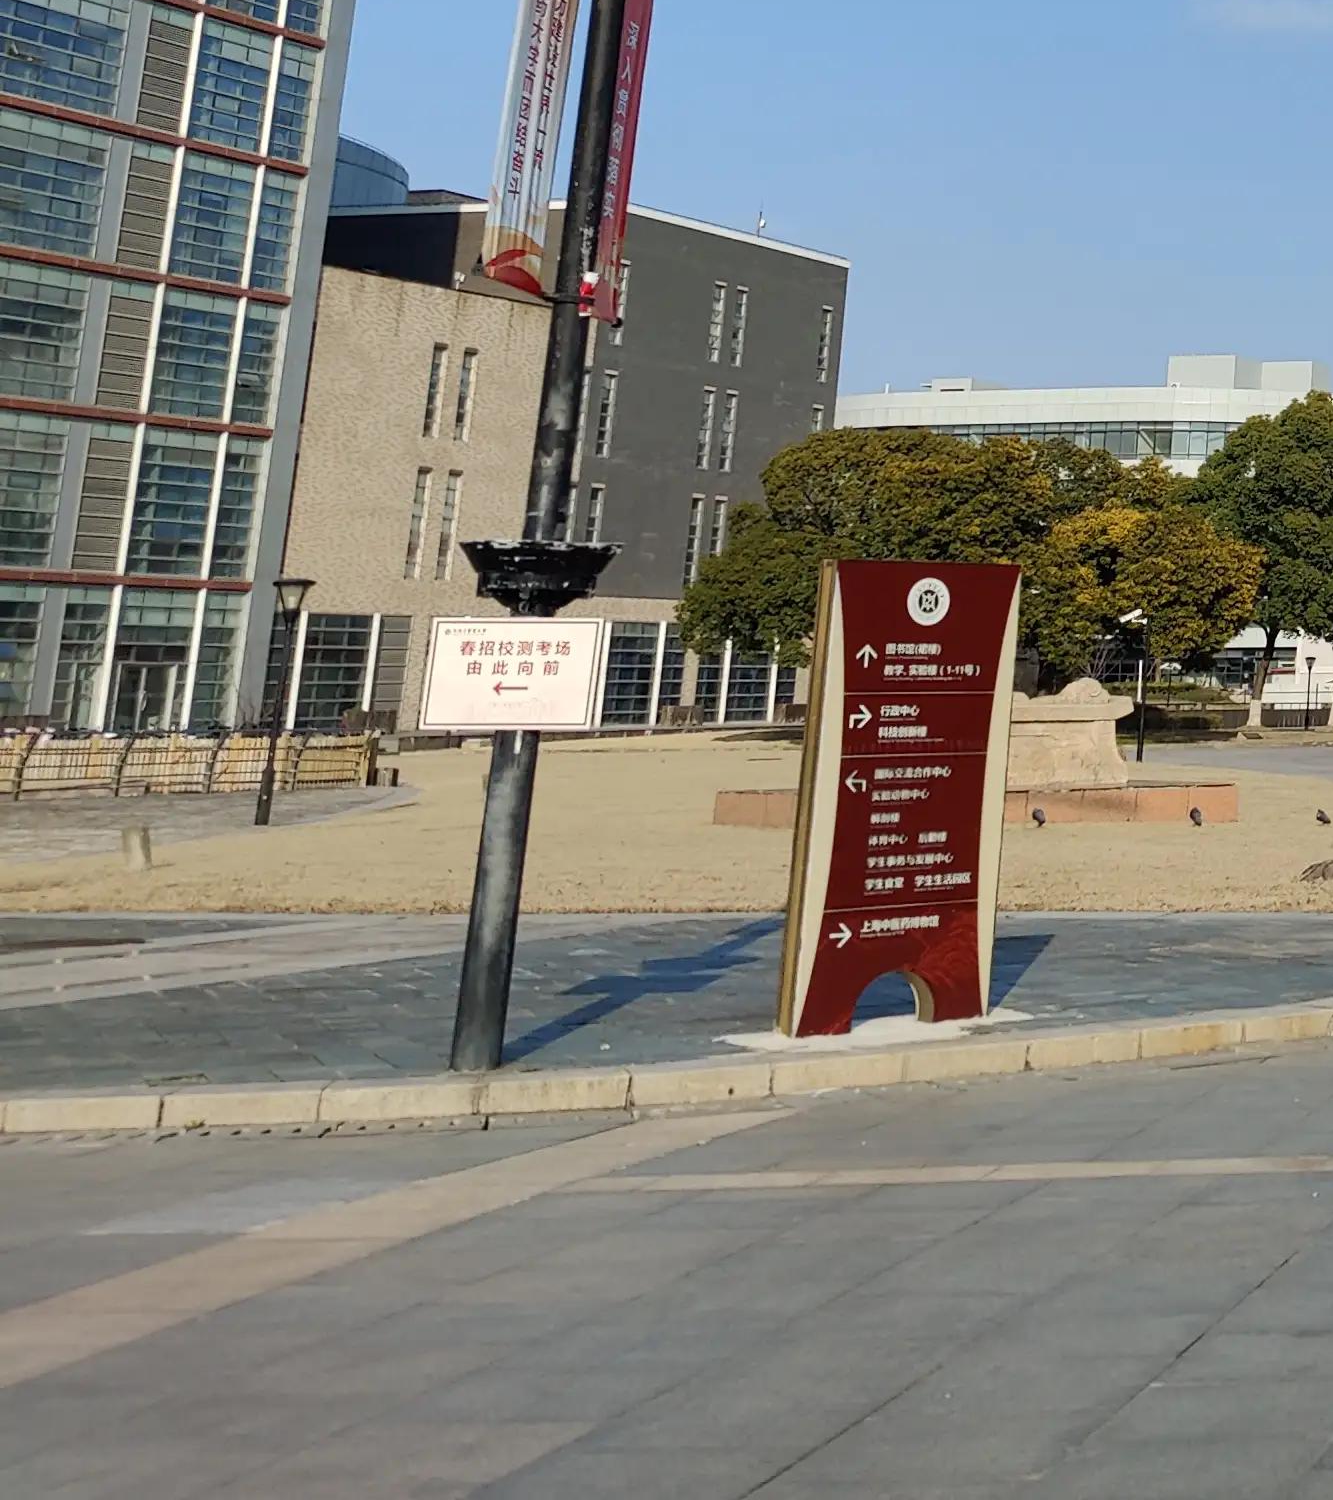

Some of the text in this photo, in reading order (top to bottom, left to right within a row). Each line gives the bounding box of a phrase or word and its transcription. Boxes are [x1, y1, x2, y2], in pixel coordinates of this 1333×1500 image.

[460, 640, 572, 657] 春招校测考场
[880, 704, 920, 717] 行政中心
[874, 765, 952, 781] 国际交流合作中心
[864, 871, 973, 891] 学生食堂 学生生活园区
[860, 914, 940, 932] 上海中医药博物馆
